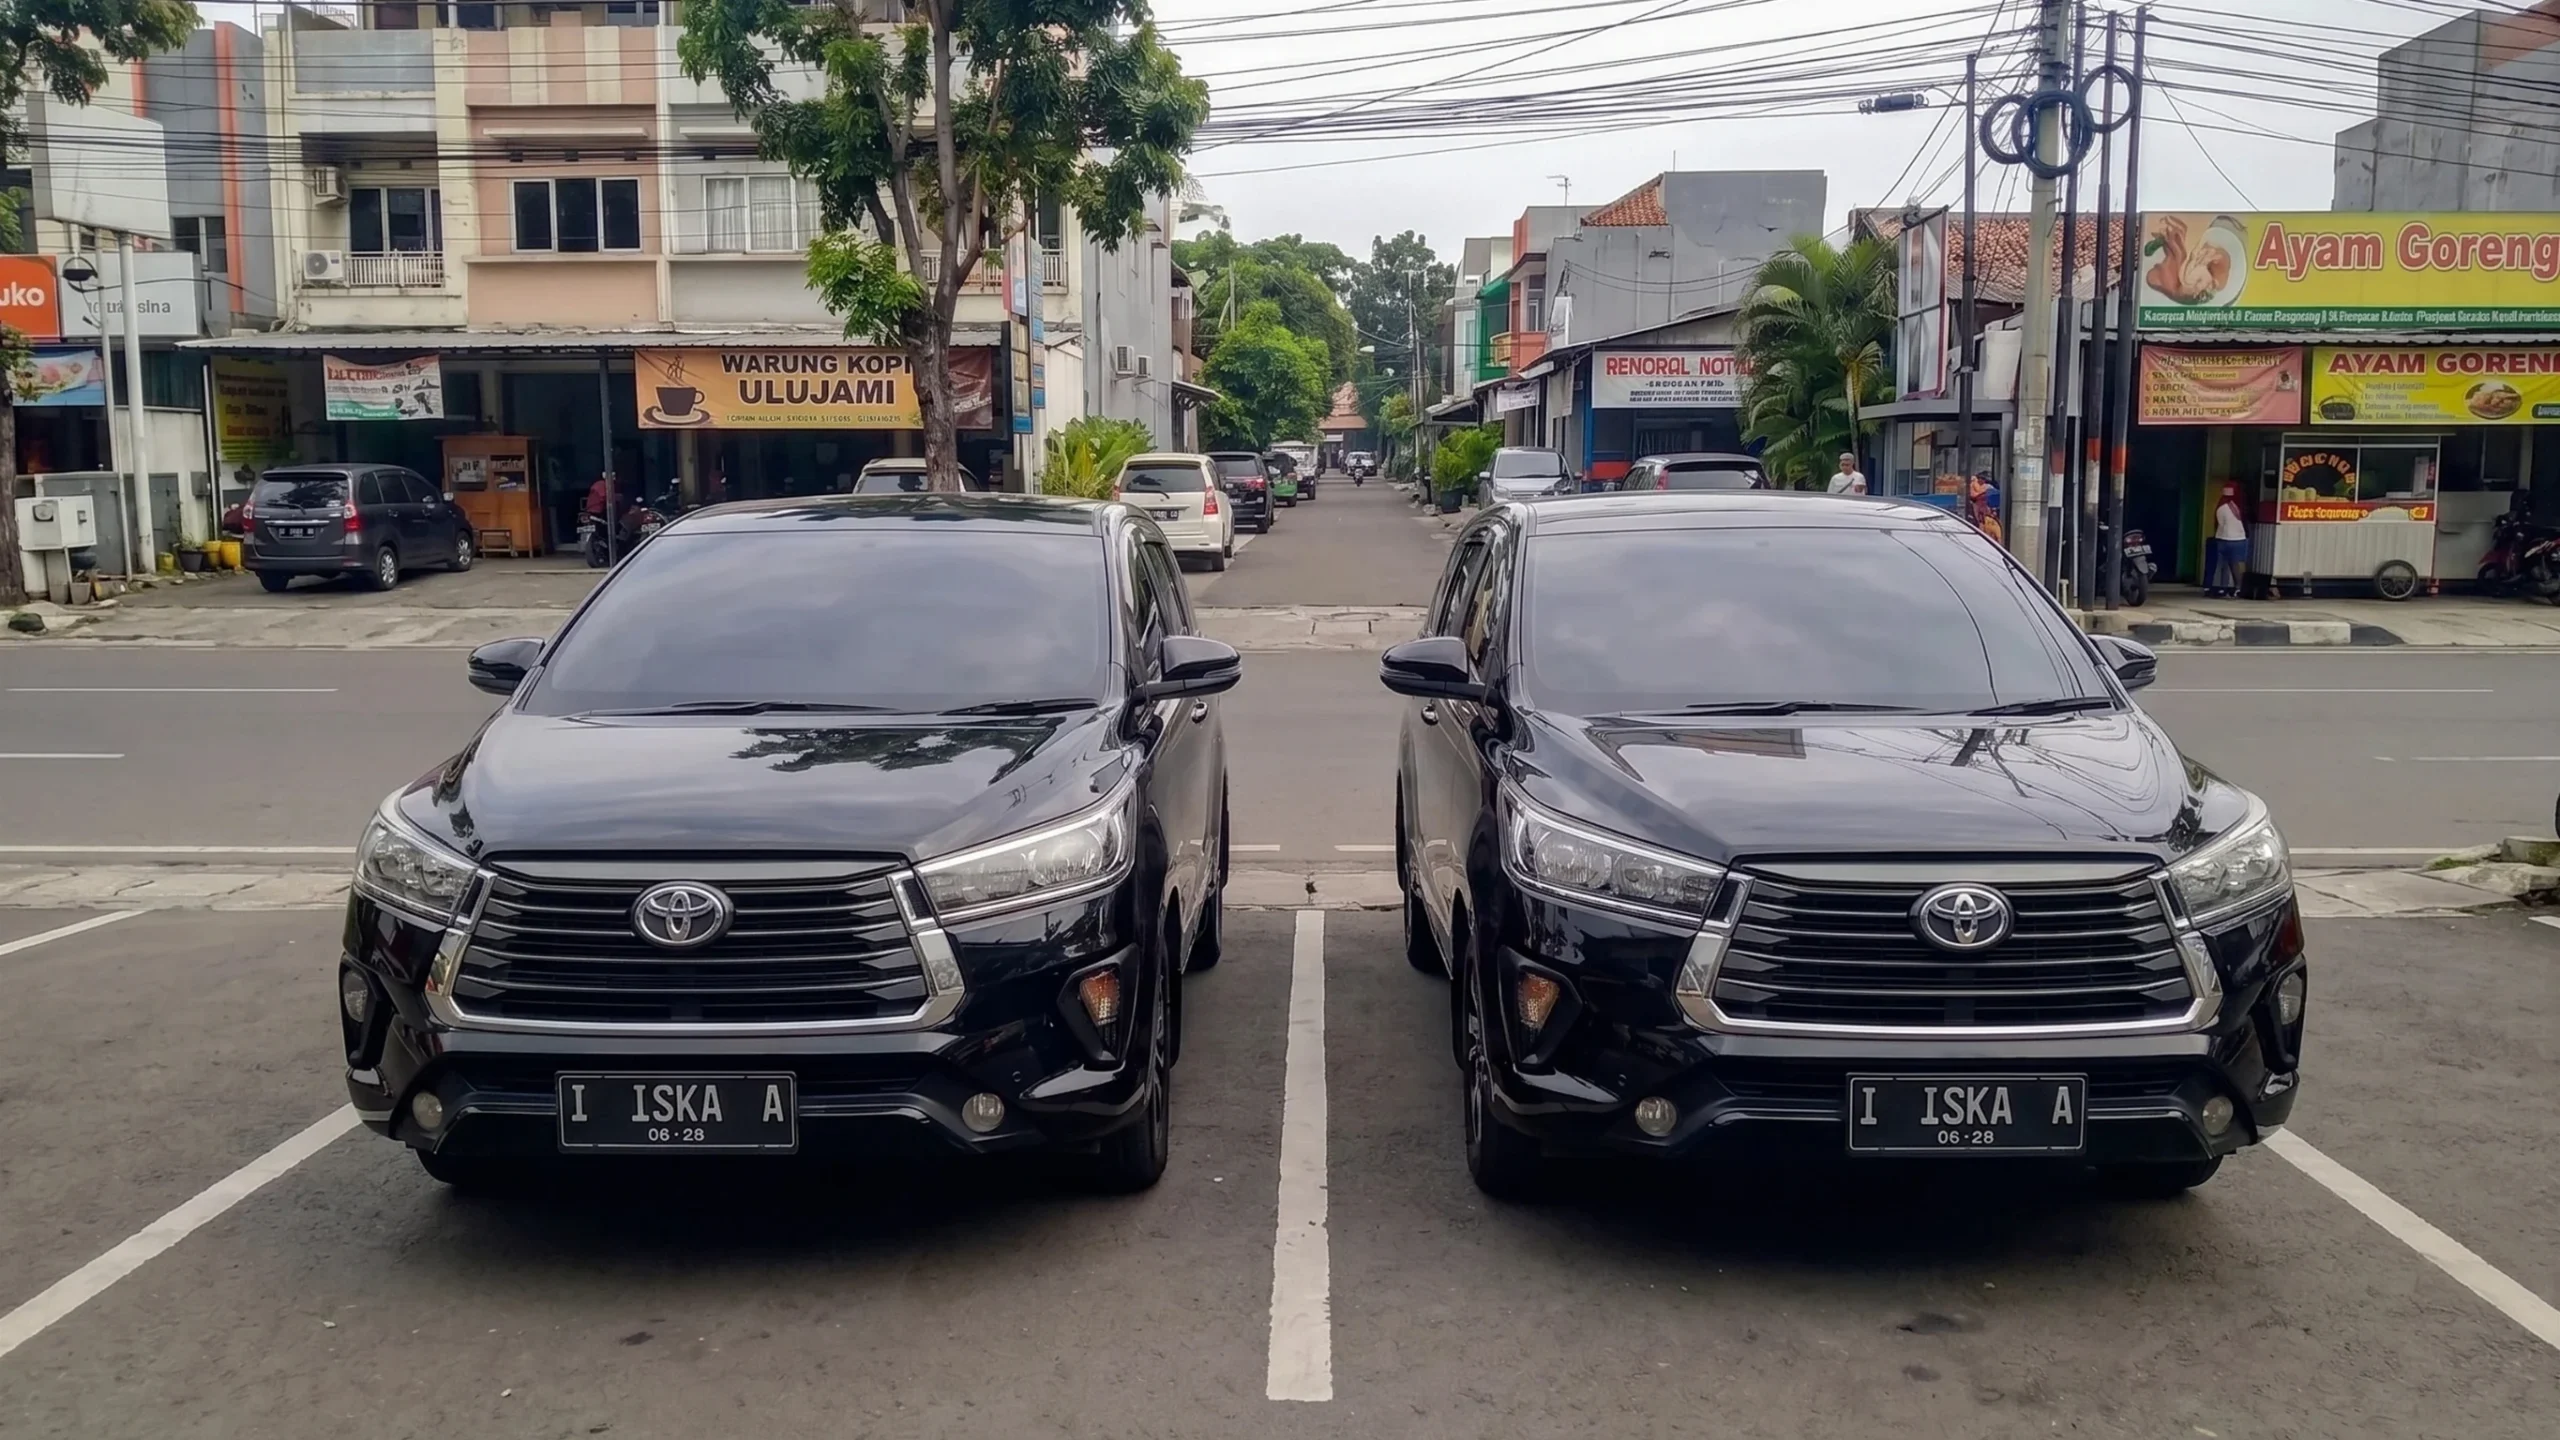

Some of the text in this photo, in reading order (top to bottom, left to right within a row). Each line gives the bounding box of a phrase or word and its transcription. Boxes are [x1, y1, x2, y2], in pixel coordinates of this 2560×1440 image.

[2254, 221, 2560, 283] Ayam Goreng
[721, 354, 911, 375] WARUNG KOPI
[2327, 352, 2427, 375] AYAM
[739, 379, 895, 405] ULUJAMI
[631, 1084, 723, 1122] ISKA
[762, 1084, 785, 1122] A
[1920, 1086, 2013, 1125] ISKA
[2052, 1086, 2073, 1124] A
